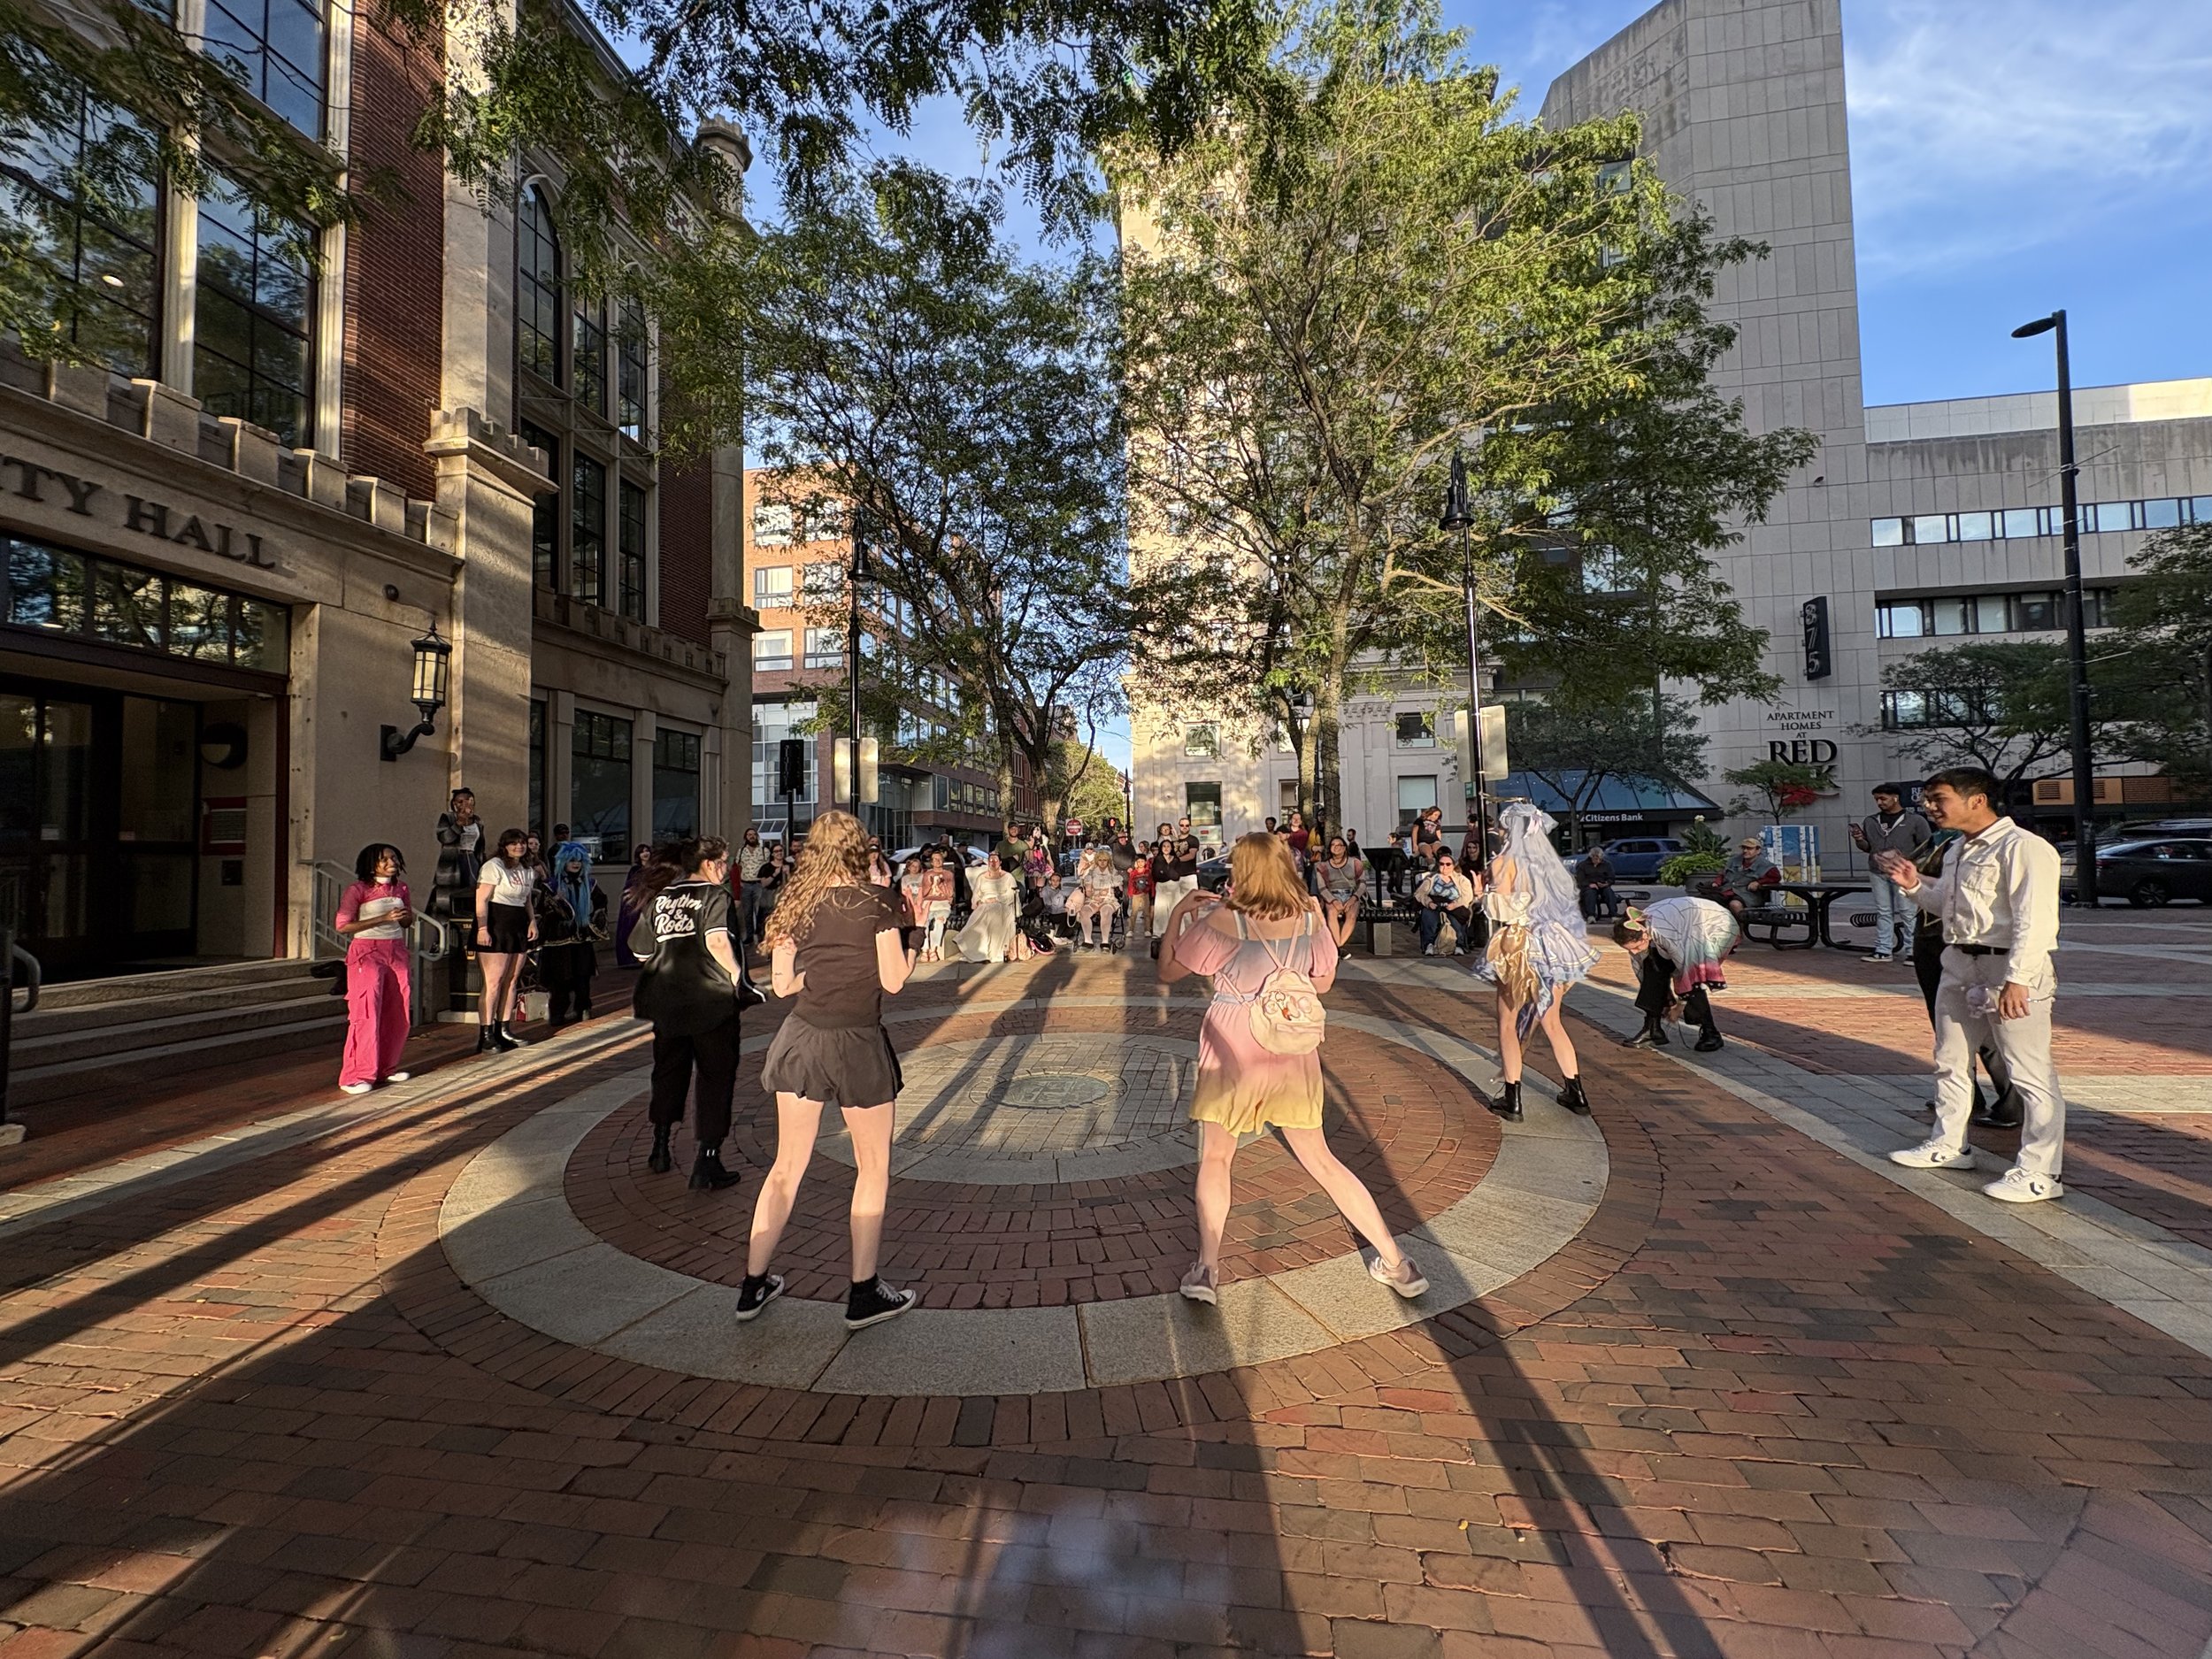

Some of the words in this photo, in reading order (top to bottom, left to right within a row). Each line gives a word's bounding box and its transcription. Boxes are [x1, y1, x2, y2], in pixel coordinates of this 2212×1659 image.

[0, 455, 103, 517] TY
[123, 494, 276, 571] HALL
[1804, 603, 1820, 674] 875
[1766, 710, 1835, 721] APARTMENT
[1780, 721, 1823, 731] HOMES
[1767, 739, 1838, 766] RED
[1585, 813, 1620, 822] Citizens
[1621, 812, 1644, 822] Bank
[655, 893, 703, 915] Rhythm
[673, 908, 683, 920] &
[654, 913, 695, 934] Roots
